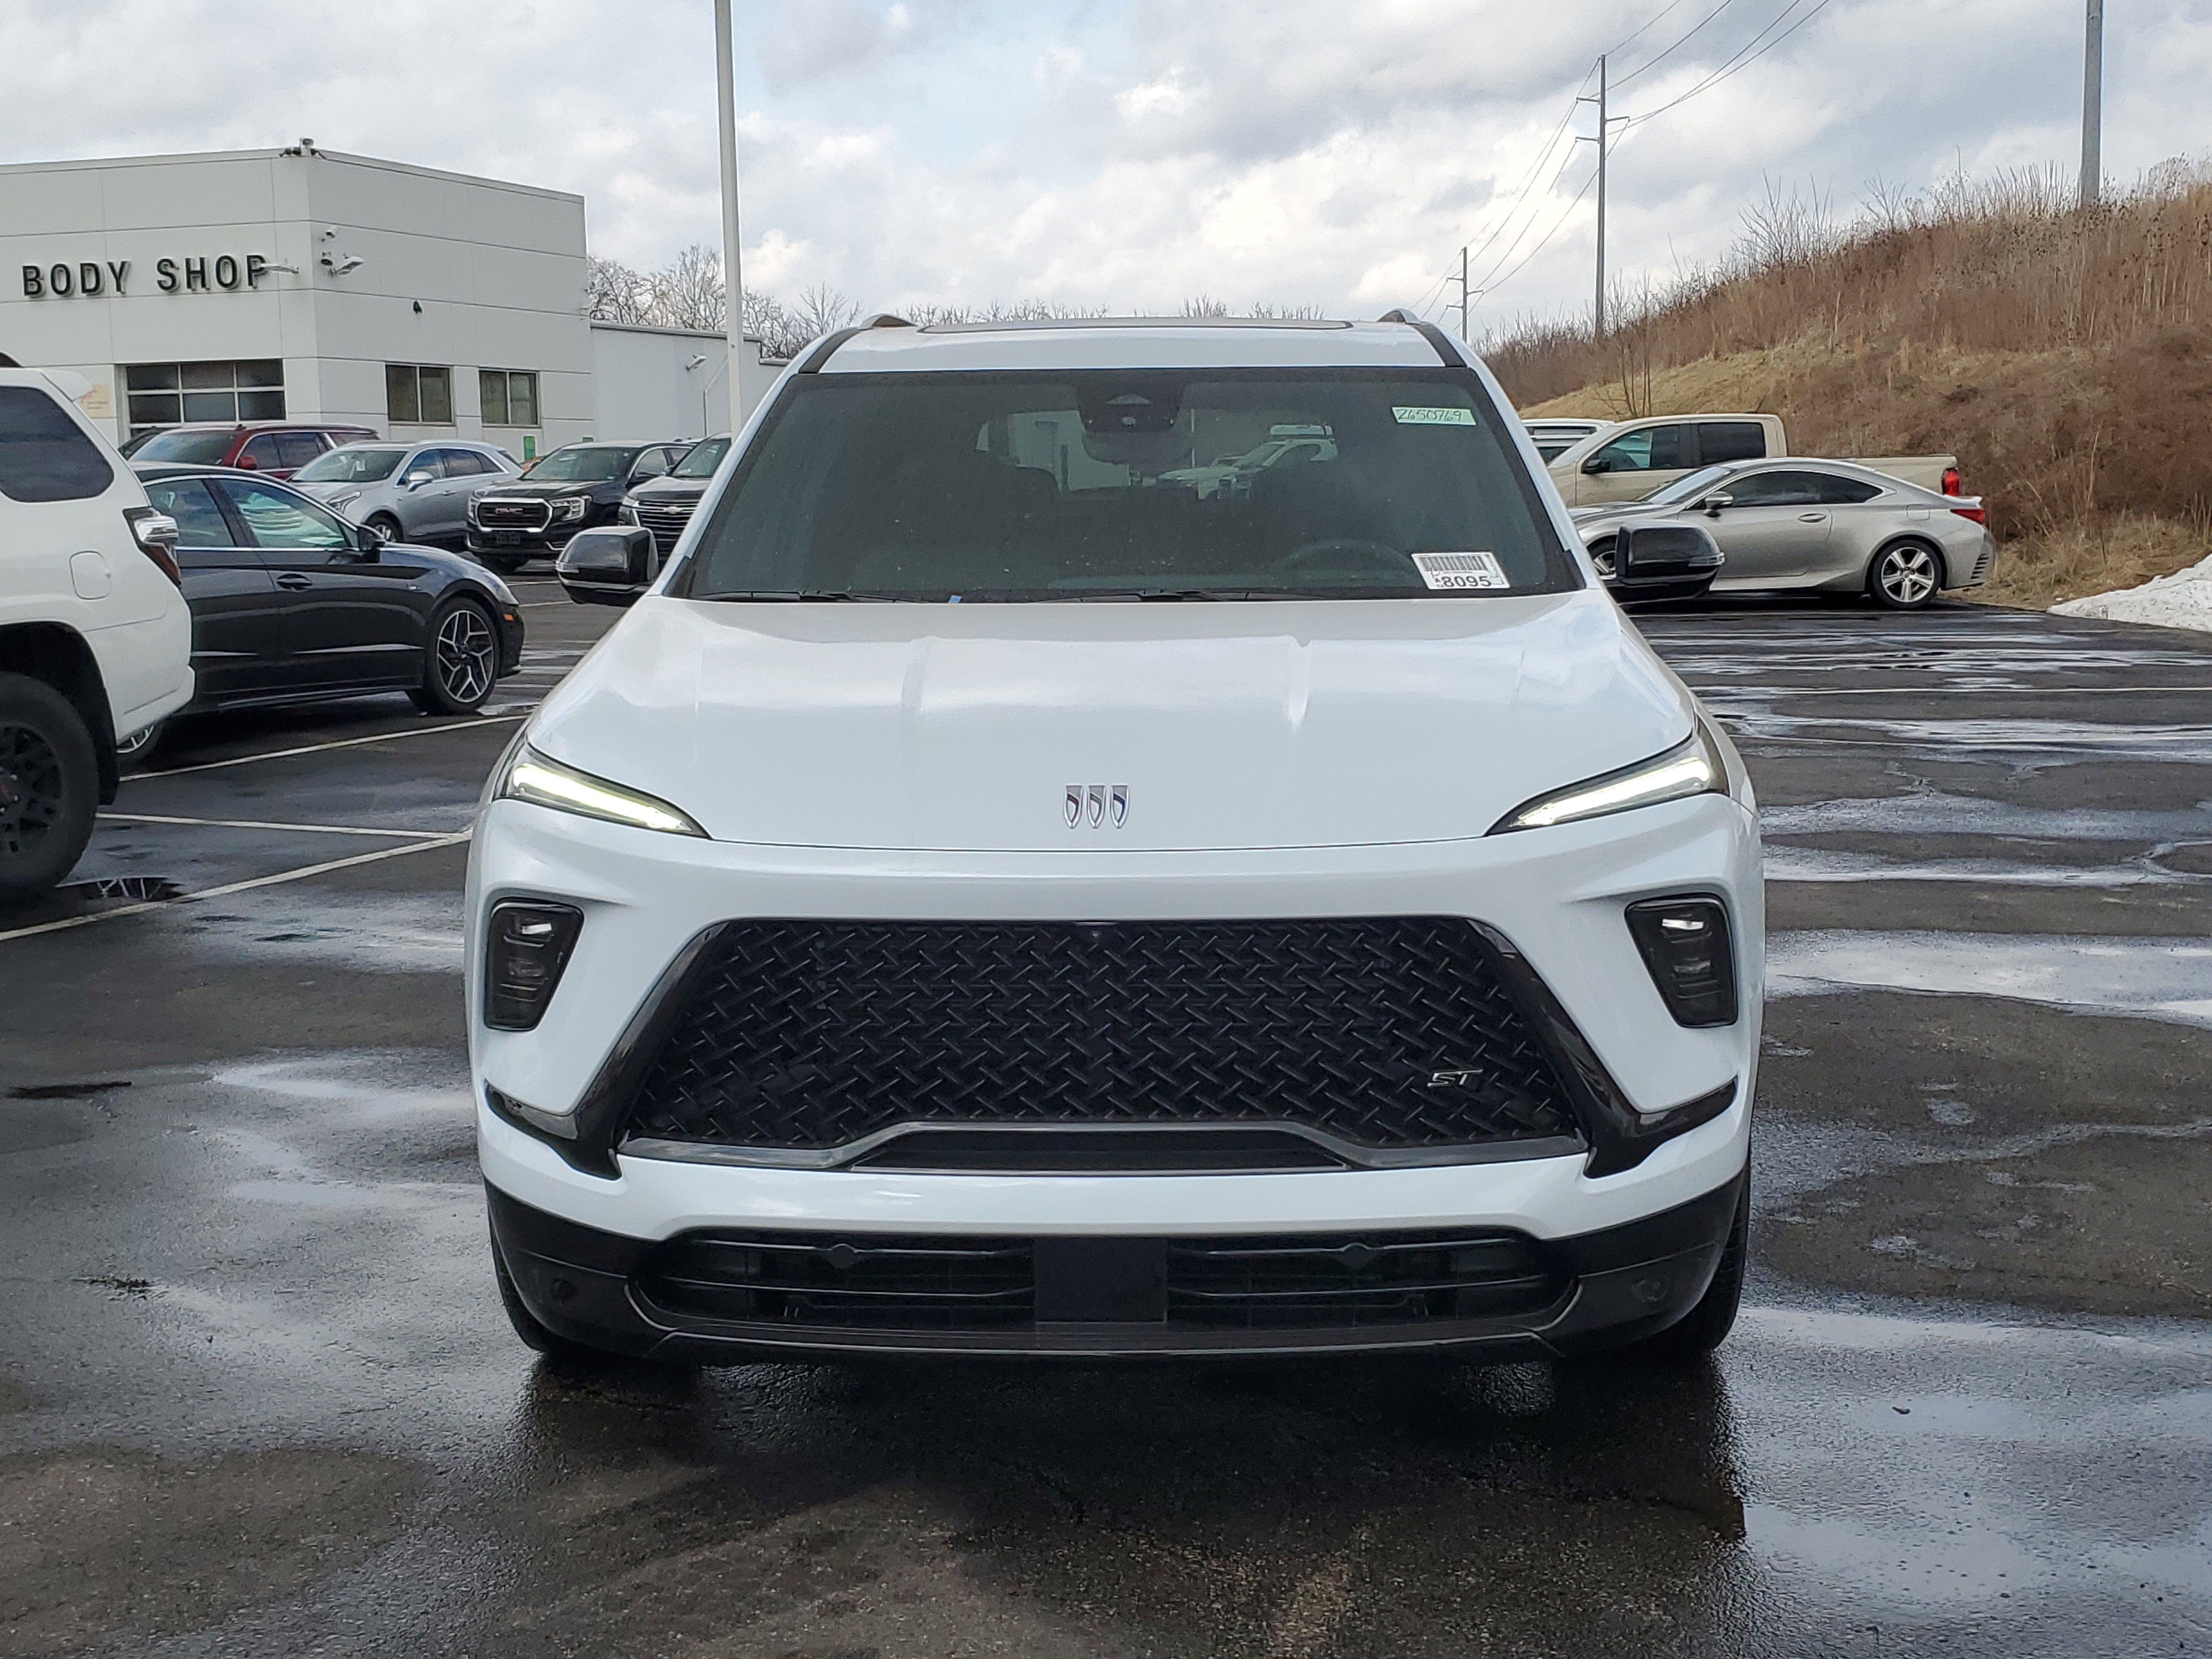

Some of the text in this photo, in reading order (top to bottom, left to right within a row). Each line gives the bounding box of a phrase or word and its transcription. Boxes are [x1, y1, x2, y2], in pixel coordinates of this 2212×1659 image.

[22, 255, 267, 297] BODY SHOP
[1396, 409, 1462, 421] 2650769
[1427, 1069, 1483, 1087] ST
